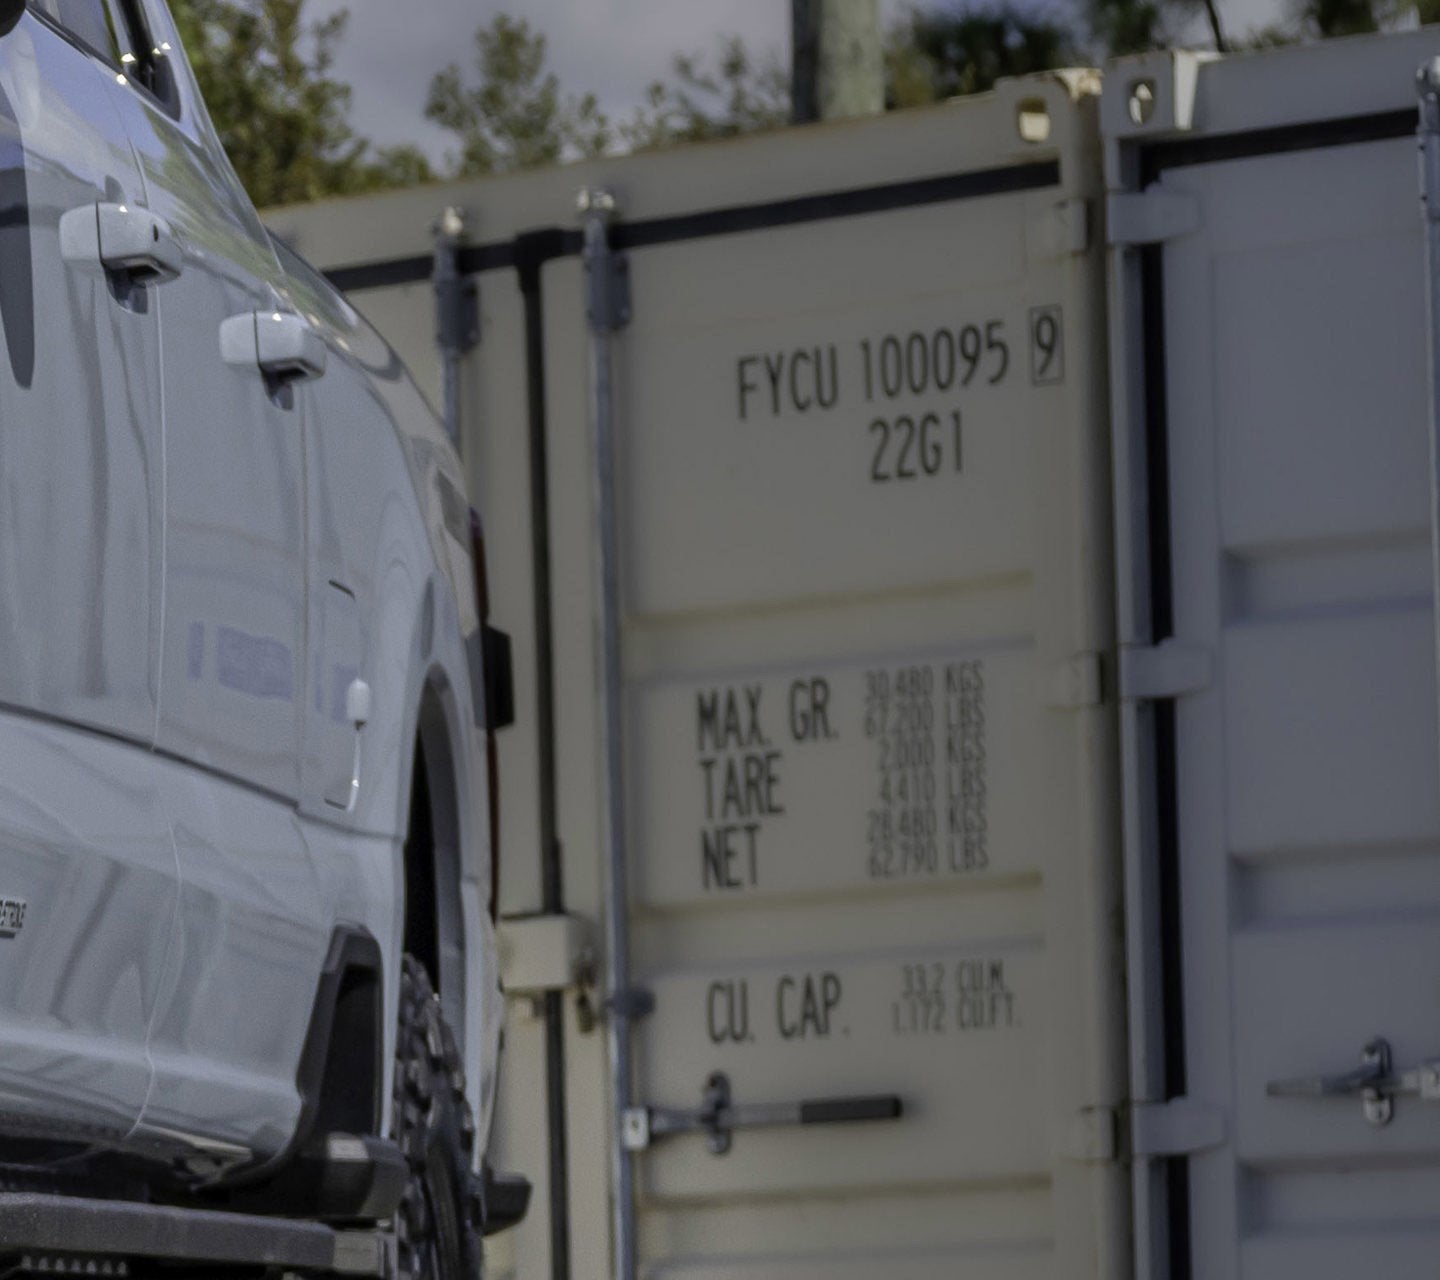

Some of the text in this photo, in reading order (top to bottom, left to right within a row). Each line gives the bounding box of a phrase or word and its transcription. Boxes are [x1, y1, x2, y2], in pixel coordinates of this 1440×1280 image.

[736, 341, 839, 421] FYCU
[860, 317, 1010, 402] 100095
[869, 406, 964, 483] 22G1
[941, 660, 985, 693] KGS
[790, 675, 840, 742] GR.
[943, 692, 986, 729] LBS
[945, 725, 987, 764] KGS
[700, 750, 786, 821] TARE
[946, 761, 988, 799] LBS
[947, 795, 989, 835] KGS
[701, 822, 762, 892] NET
[948, 830, 991, 874] LBS
[776, 971, 851, 1040] CAP.
